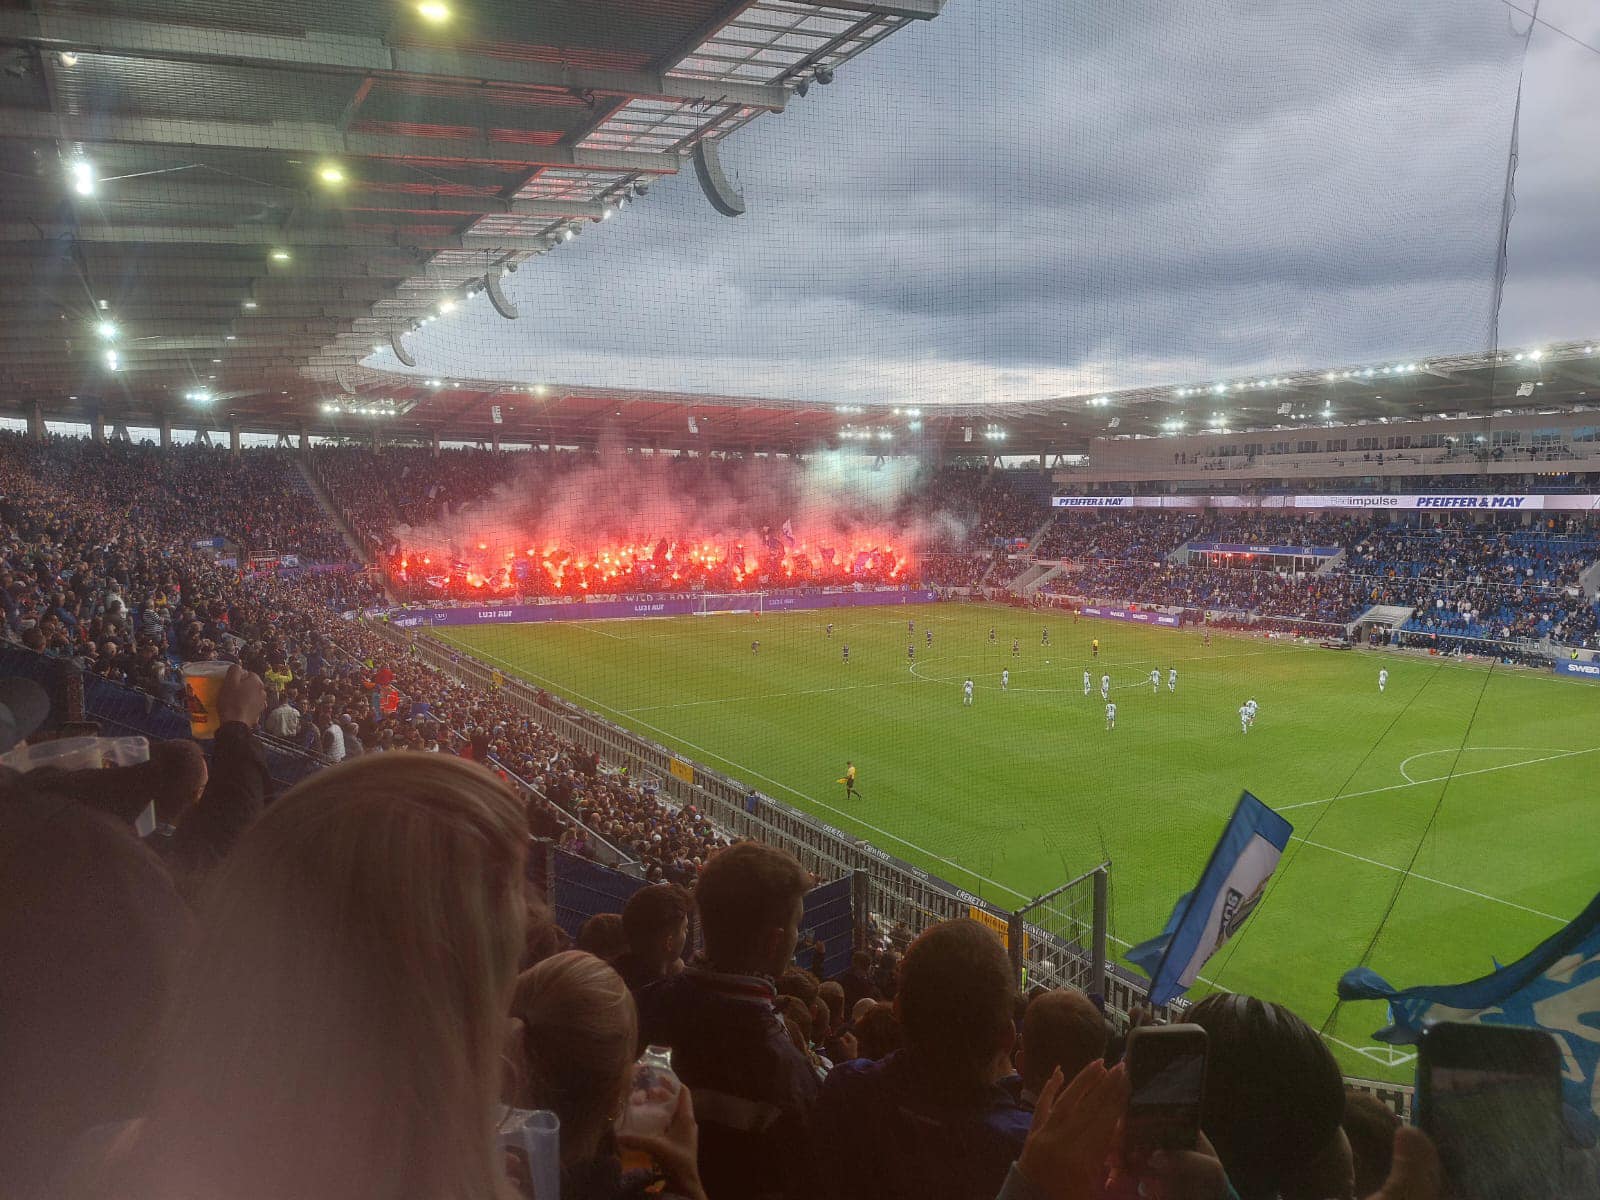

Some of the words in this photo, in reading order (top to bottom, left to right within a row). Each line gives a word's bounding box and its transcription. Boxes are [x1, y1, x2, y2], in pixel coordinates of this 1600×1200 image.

[1059, 498, 1098, 506] PFEIFFER
[1105, 498, 1124, 506] MAY
[1416, 497, 1478, 508] PFEIFFER
[1478, 497, 1489, 508] &
[1491, 497, 1525, 508] MAY
